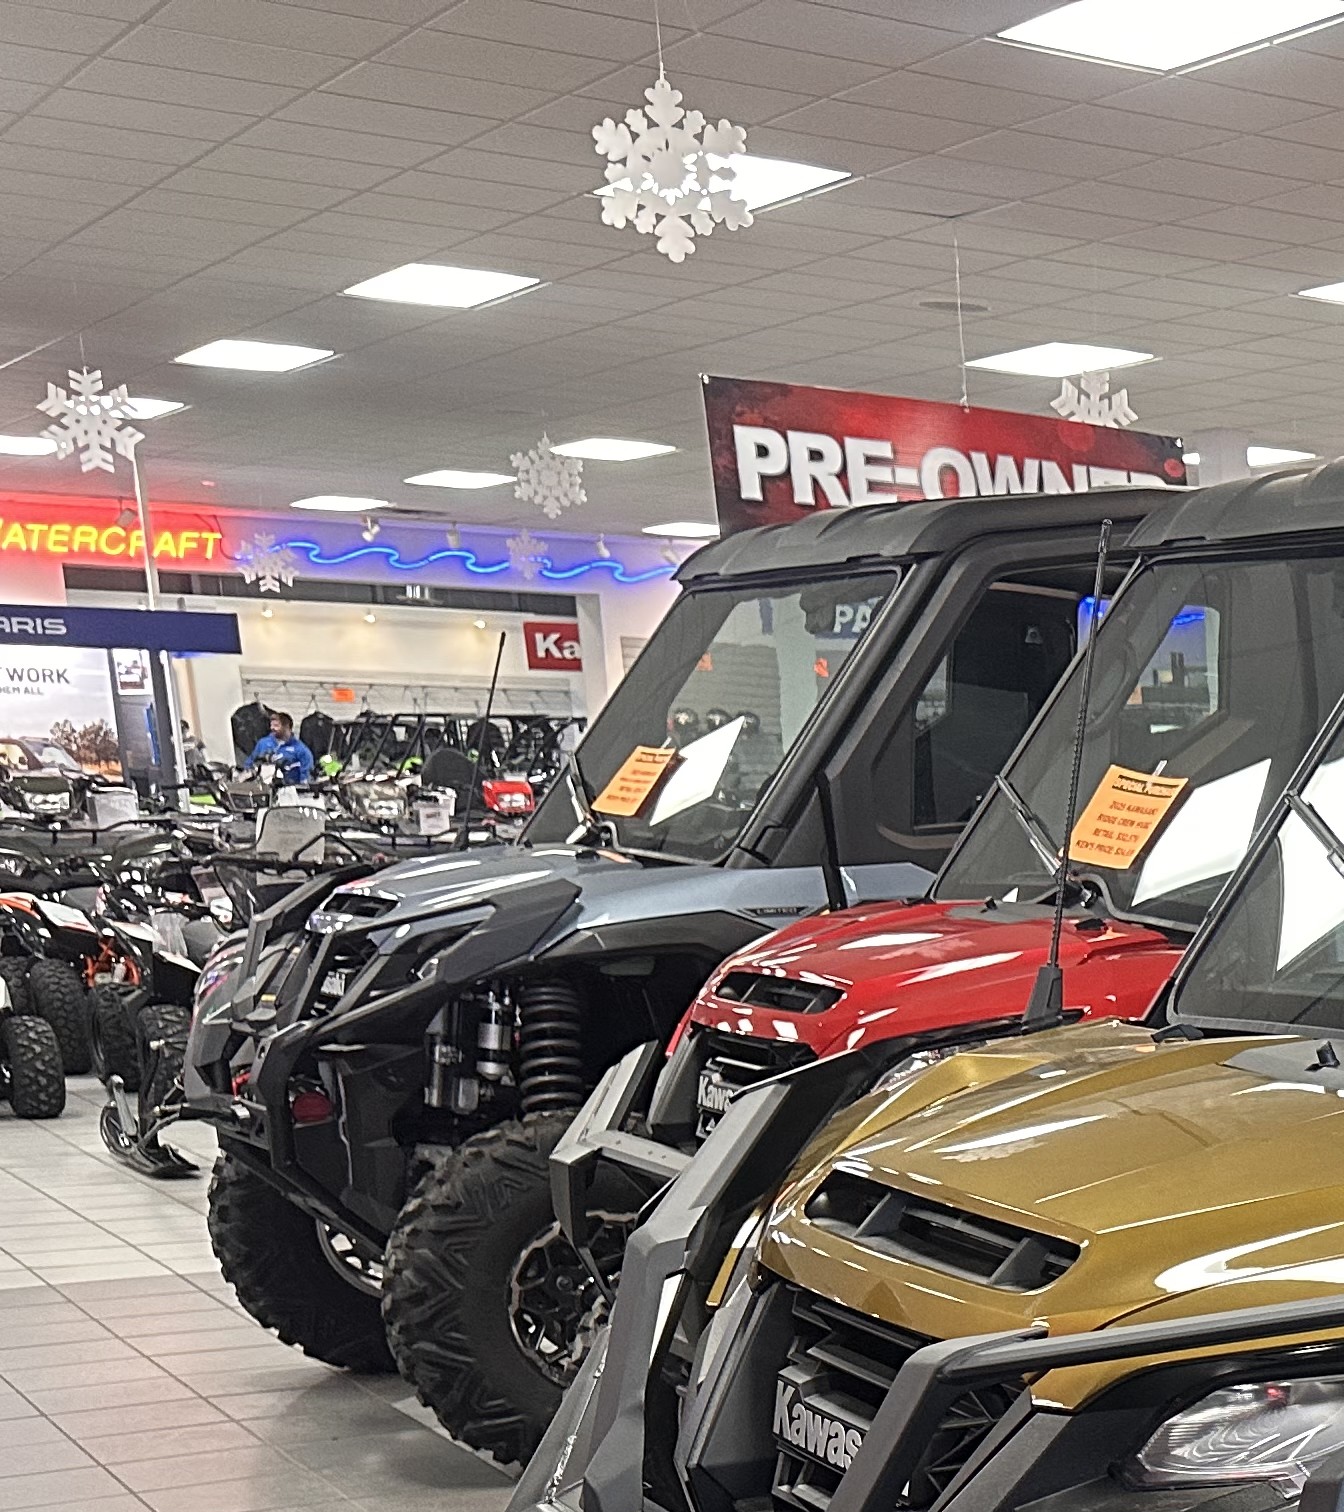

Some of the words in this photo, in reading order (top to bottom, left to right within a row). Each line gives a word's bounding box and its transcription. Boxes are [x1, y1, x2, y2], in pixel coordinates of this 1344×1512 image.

[733, 424, 1166, 508] PRE-OWN
[0, 522, 222, 560] ATERCRAFT
[5, 667, 71, 684] WORK
